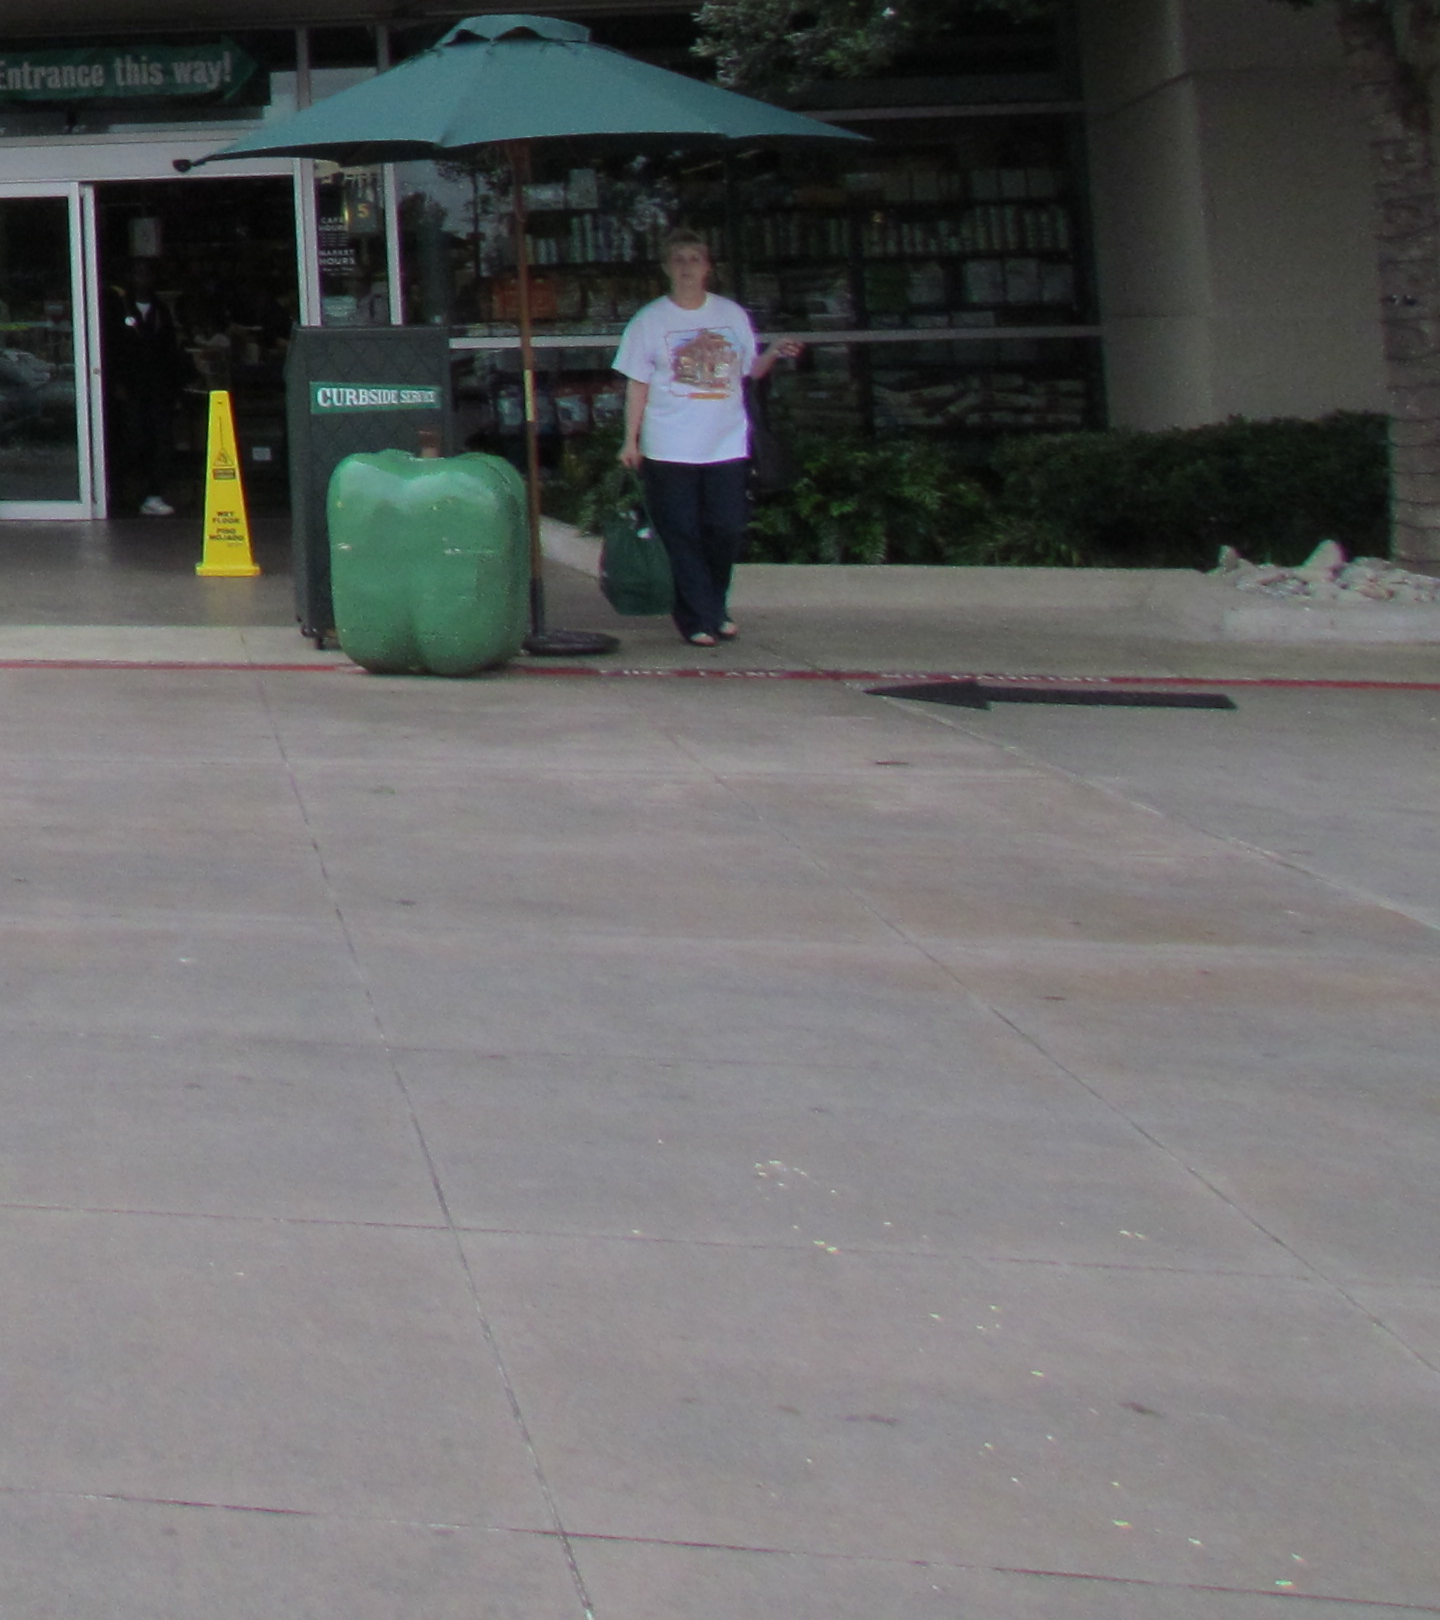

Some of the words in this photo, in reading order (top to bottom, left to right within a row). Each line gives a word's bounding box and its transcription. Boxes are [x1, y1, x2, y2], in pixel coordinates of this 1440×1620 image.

[114, 55, 163, 86] this
[172, 51, 232, 89] way!
[317, 387, 398, 408] CURBSIDE
